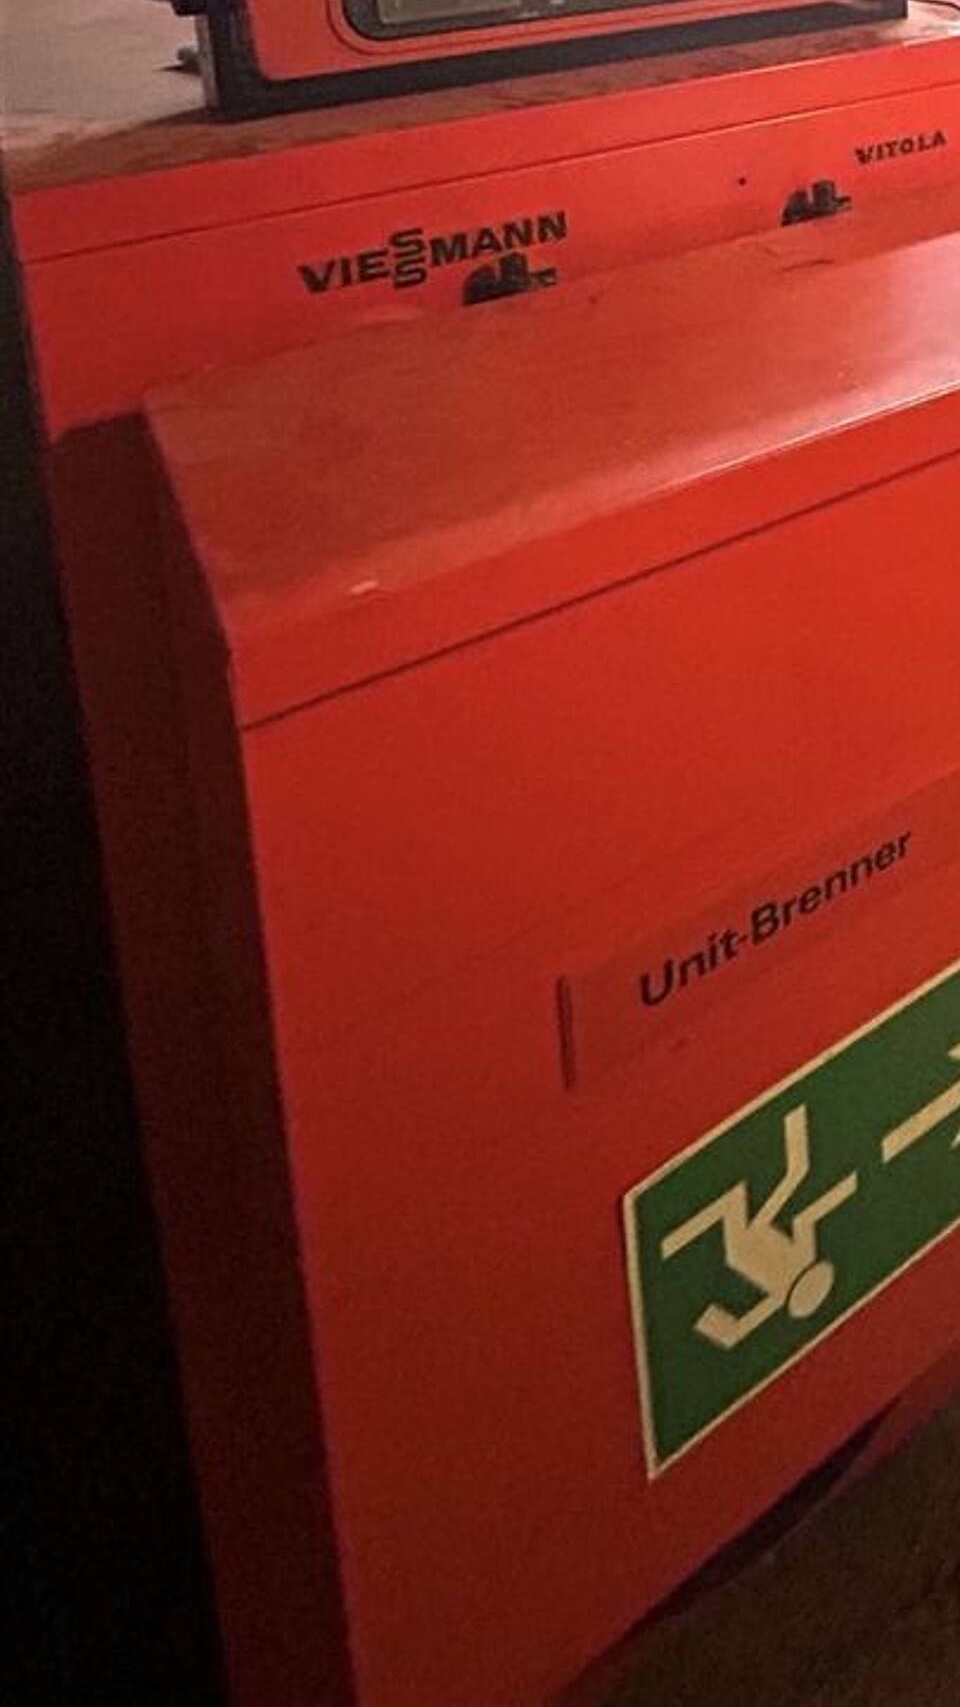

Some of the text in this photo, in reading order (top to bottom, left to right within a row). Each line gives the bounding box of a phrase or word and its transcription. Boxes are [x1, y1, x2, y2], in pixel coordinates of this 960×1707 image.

[855, 129, 946, 164] VITOLA
[299, 210, 567, 293] VIESSMANN
[640, 831, 911, 1006] Unit-Brenner
